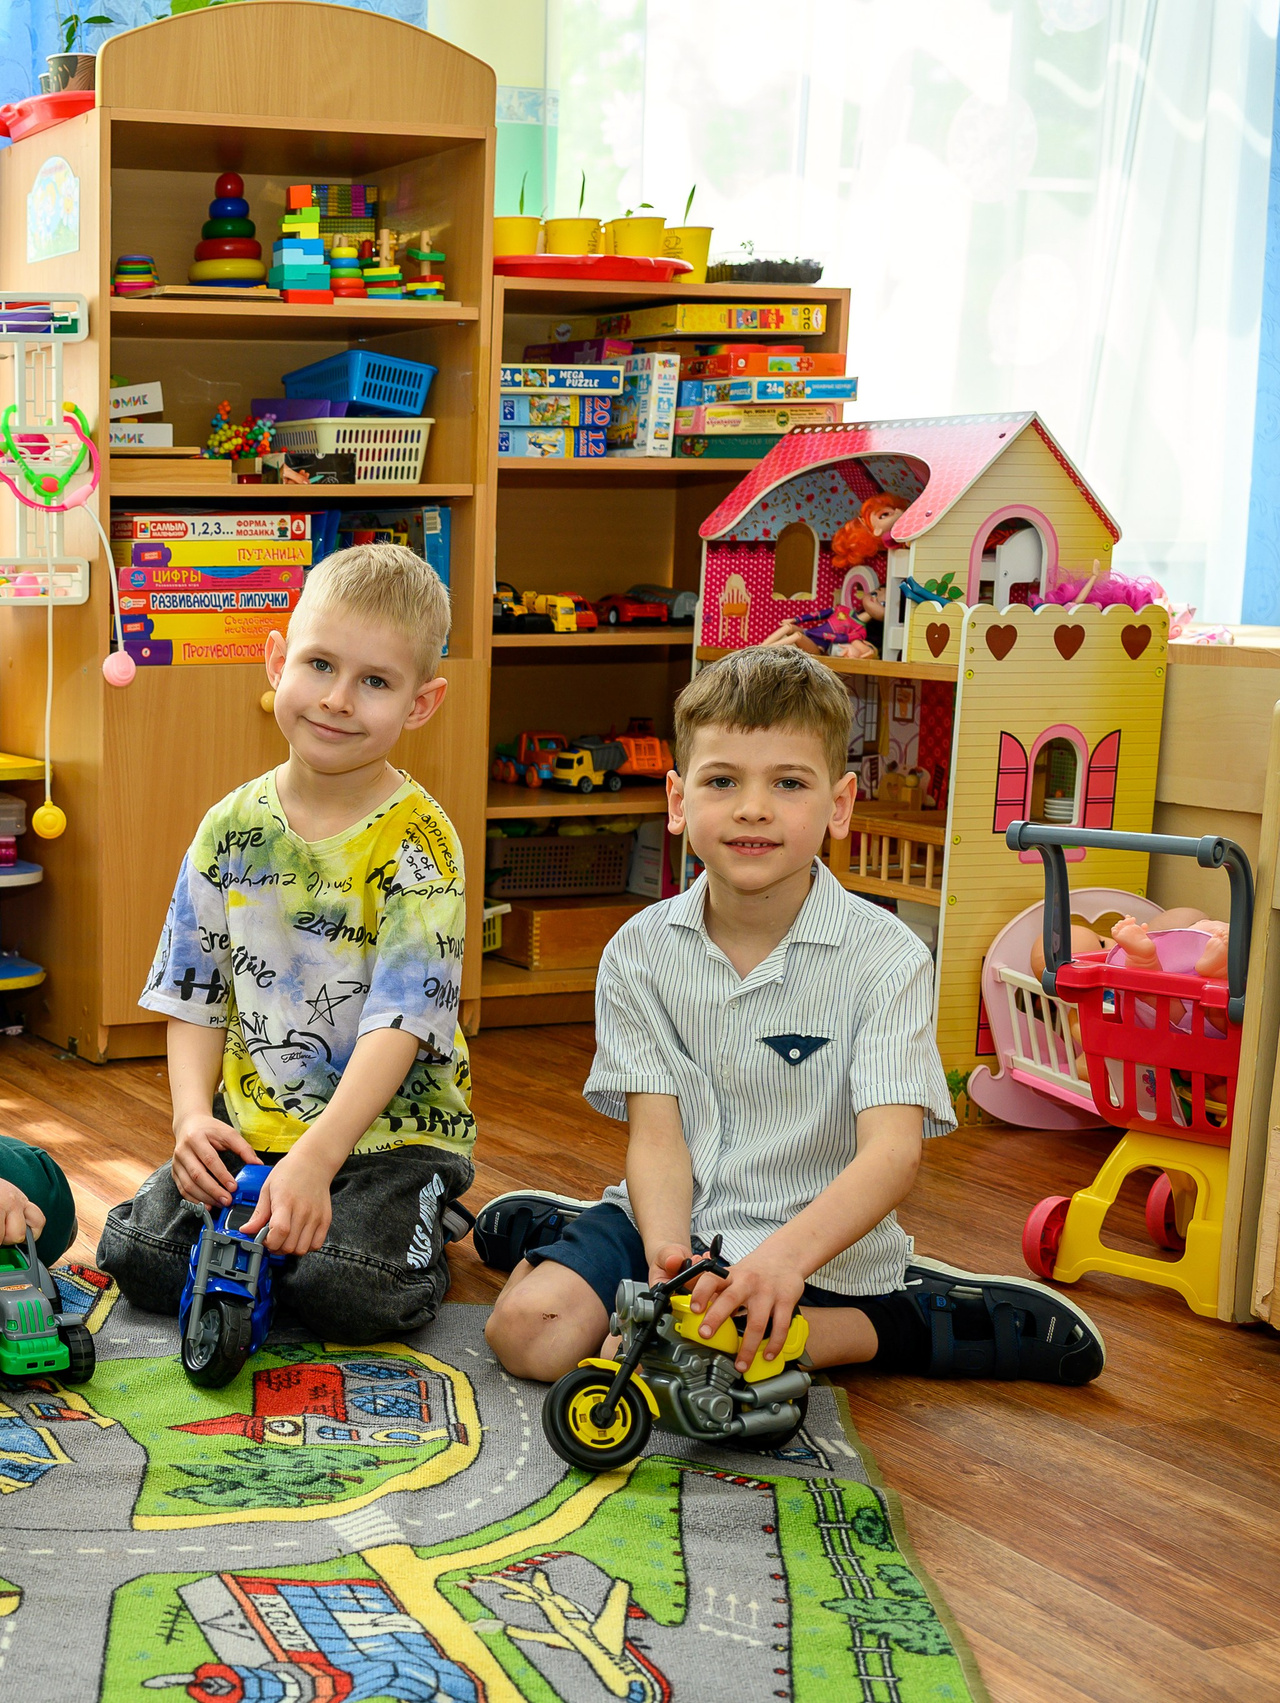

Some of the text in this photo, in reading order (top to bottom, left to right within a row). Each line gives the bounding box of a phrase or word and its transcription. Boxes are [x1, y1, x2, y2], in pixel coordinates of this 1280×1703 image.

[625, 358, 651, 372] ПАЗЛ
[559, 370, 585, 379] MEGA
[658, 373, 677, 381] ПАЗЛ
[565, 378, 600, 388] PUZZLE
[766, 382, 779, 392] 24
[110, 394, 149, 409] ОМИК
[594, 397, 611, 426] 20
[587, 431, 605, 456] 12
[151, 522, 187, 532] САМЫМ
[189, 521, 234, 537] 1,2,3...
[236, 519, 268, 528] ФОРМА
[236, 528, 275, 537] МОЗАИКА
[237, 547, 305, 562] ПУТАНИЦА
[152, 569, 202, 584] ЦИФРЫ
[151, 591, 289, 612] РАЗВИВАЮЩИЕ ЛИПУЧКИ
[252, 1594, 312, 1652] AIRPORT
